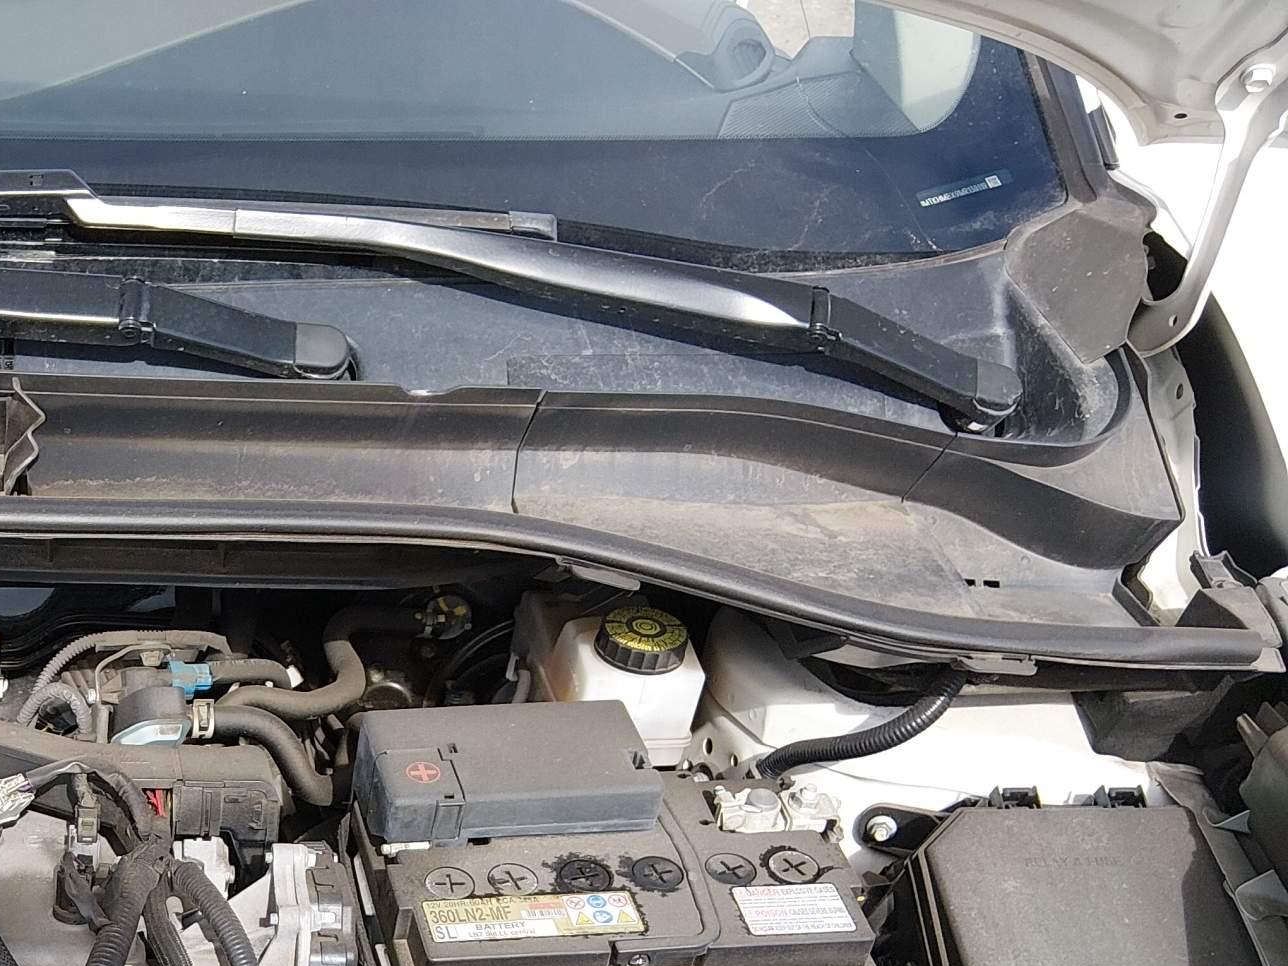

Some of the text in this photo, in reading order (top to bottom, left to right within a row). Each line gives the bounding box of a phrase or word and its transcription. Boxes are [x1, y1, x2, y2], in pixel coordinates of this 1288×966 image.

[430, 905, 512, 924] 360LN2-MF
[434, 925, 457, 940] SL
[475, 921, 526, 931] BATTERY
